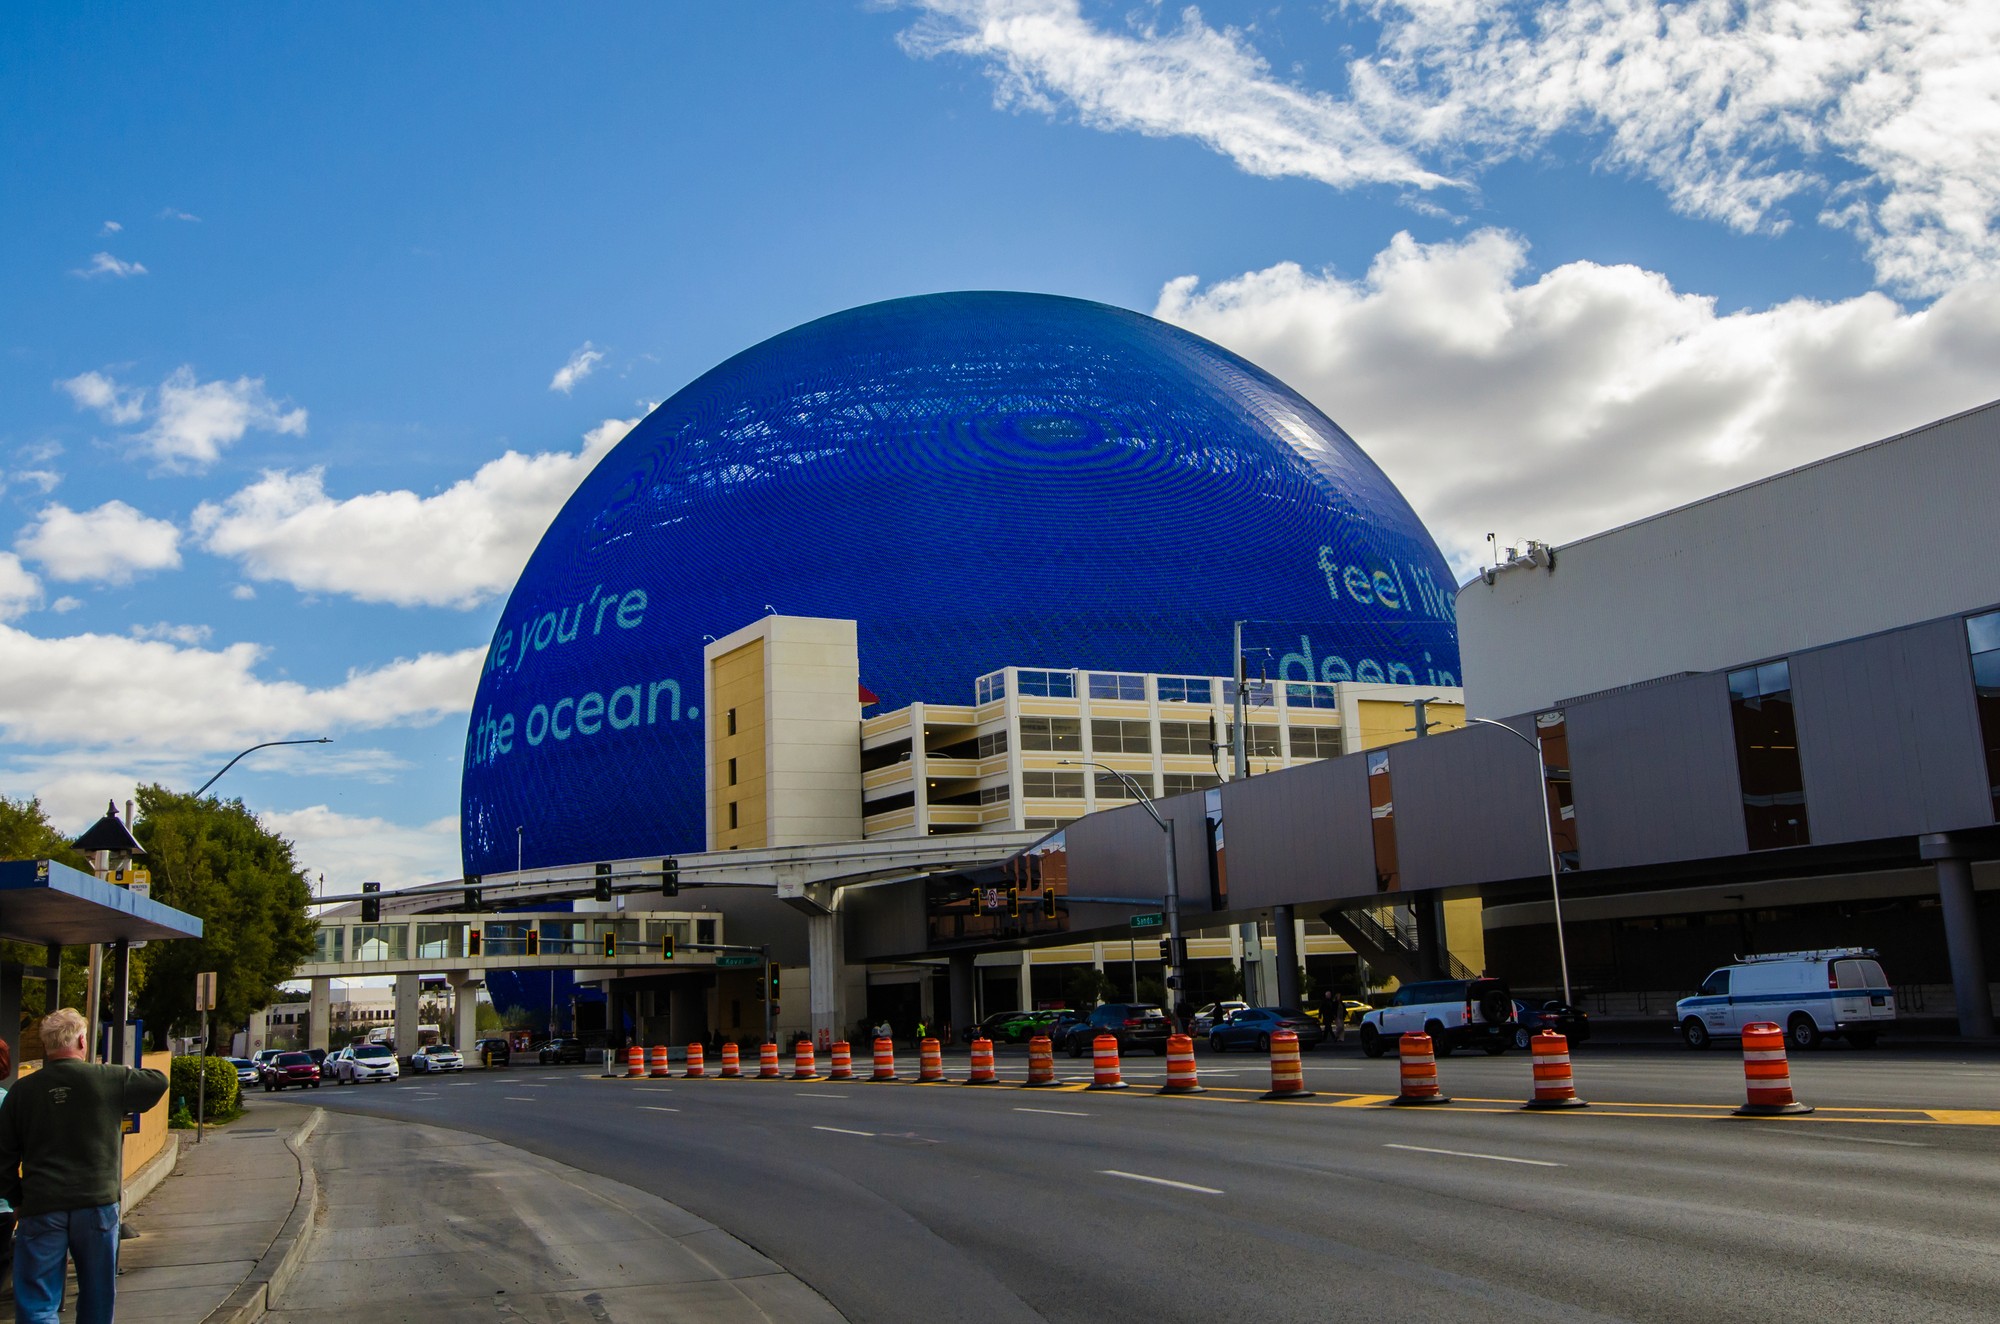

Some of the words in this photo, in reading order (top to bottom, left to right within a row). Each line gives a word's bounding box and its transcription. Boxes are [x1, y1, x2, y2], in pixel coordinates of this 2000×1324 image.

[1317, 545, 1412, 612] feel
[514, 584, 648, 672] you're
[476, 704, 515, 766] the
[526, 678, 699, 746] ocean.
[1136, 916, 1153, 926] Sands
[725, 958, 745, 966] Koval
